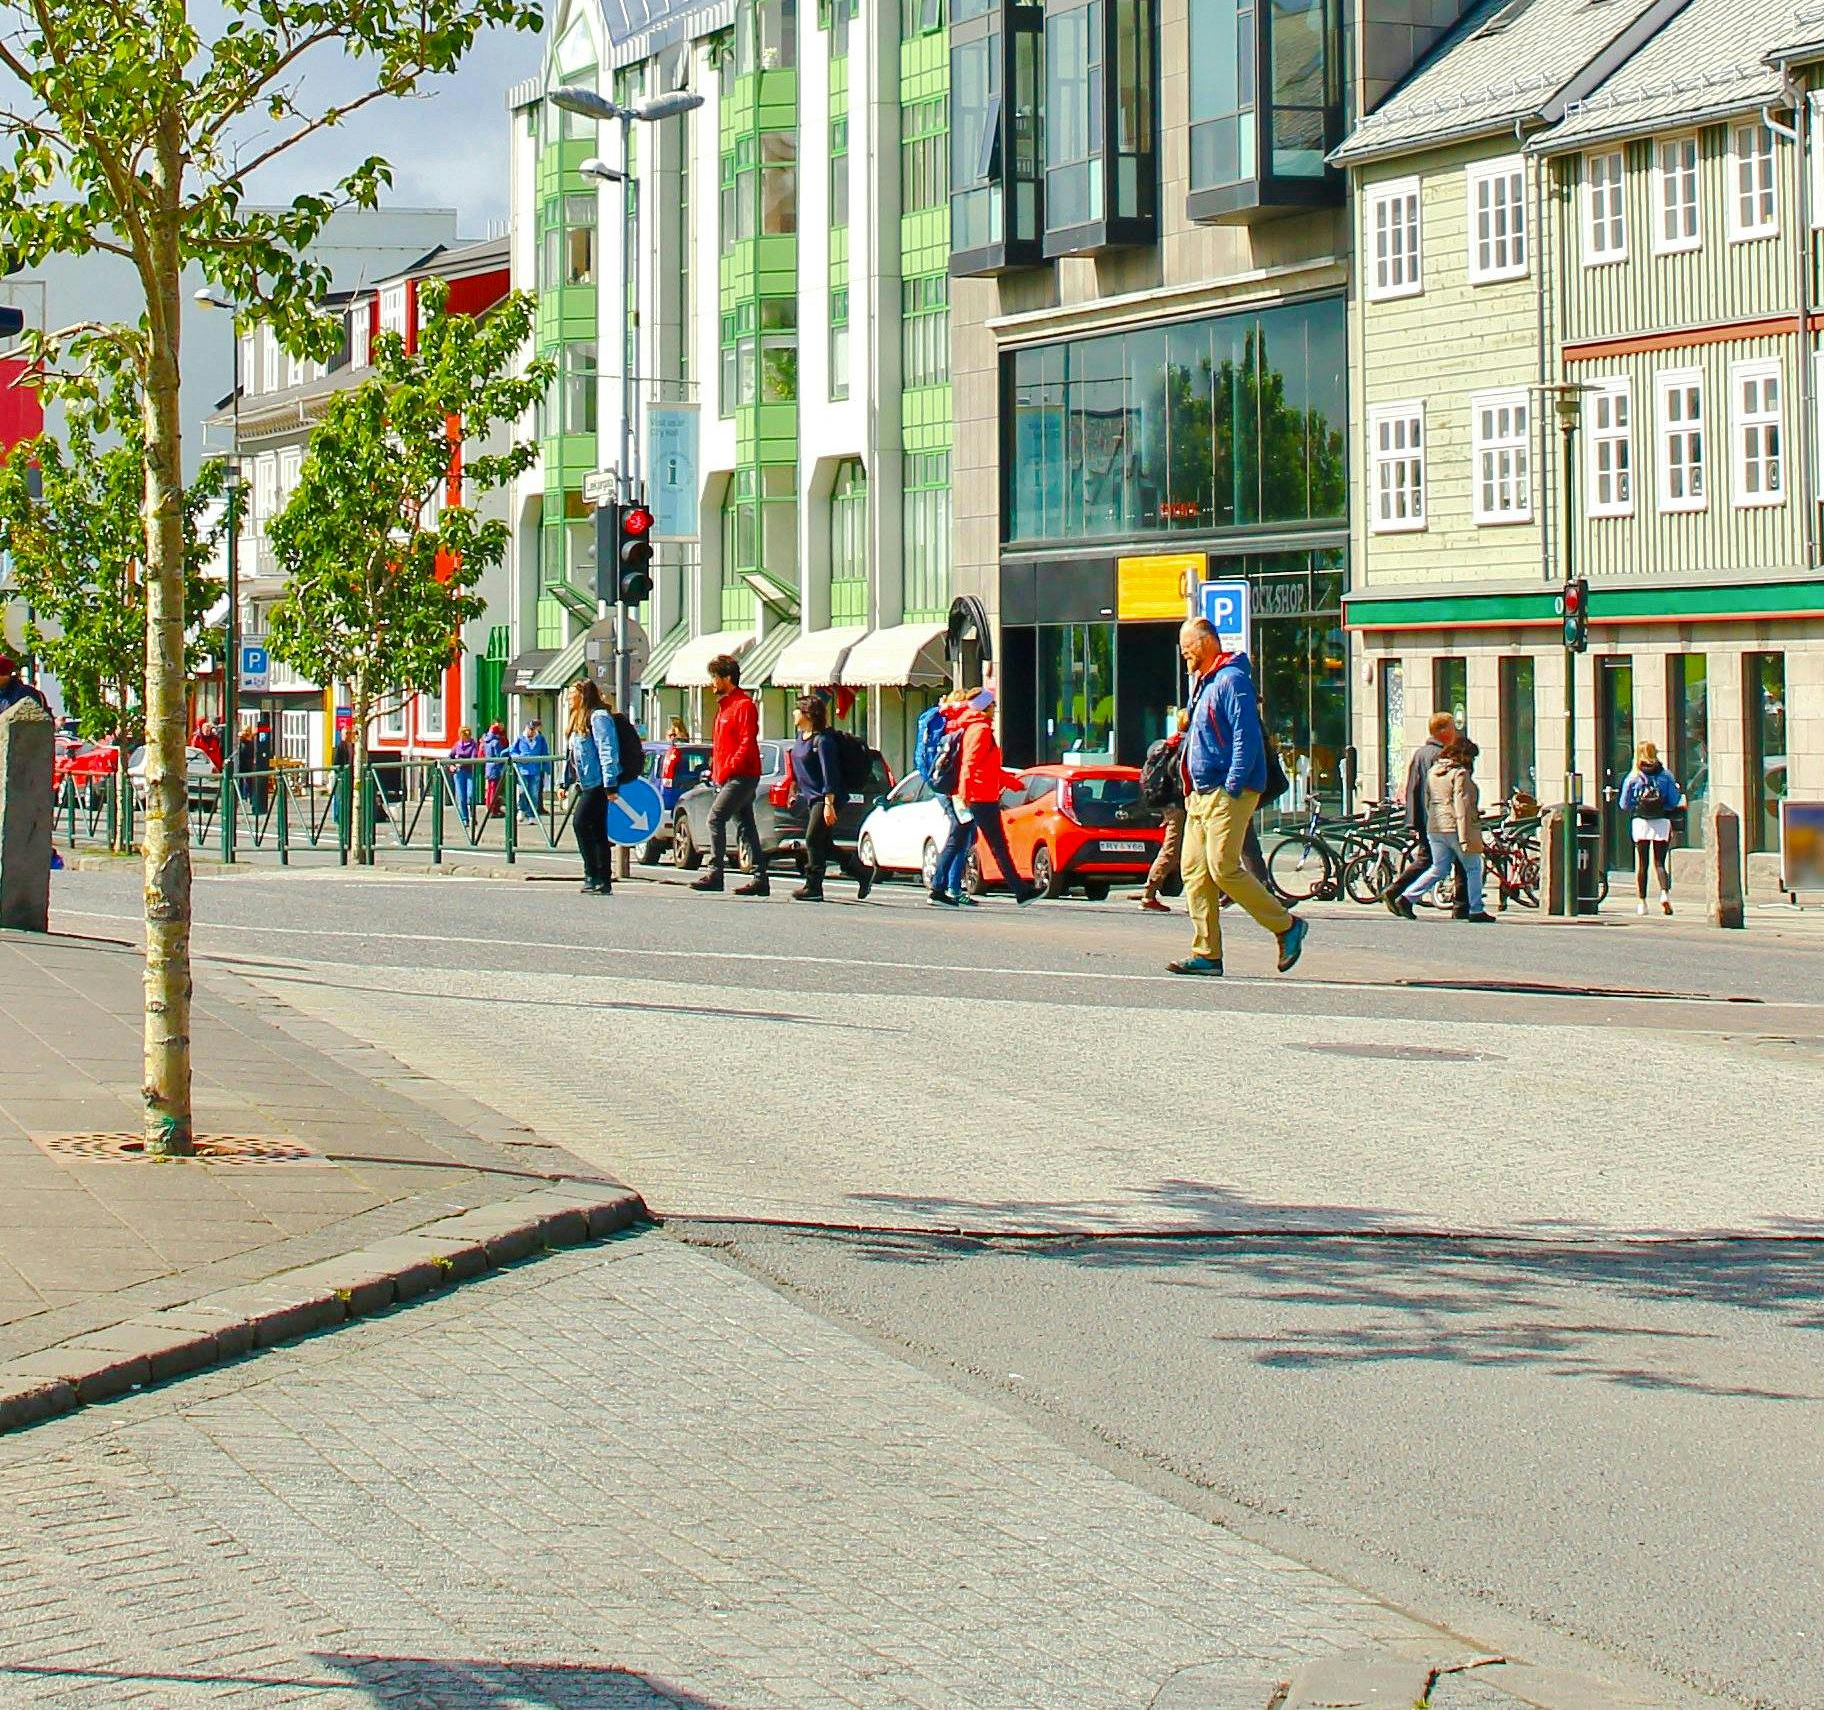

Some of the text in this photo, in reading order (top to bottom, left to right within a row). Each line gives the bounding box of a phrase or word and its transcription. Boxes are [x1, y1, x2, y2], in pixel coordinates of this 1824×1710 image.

[1214, 597, 1233, 627] P
[1249, 584, 1304, 614] OCK SHOP
[249, 652, 261, 669] P
